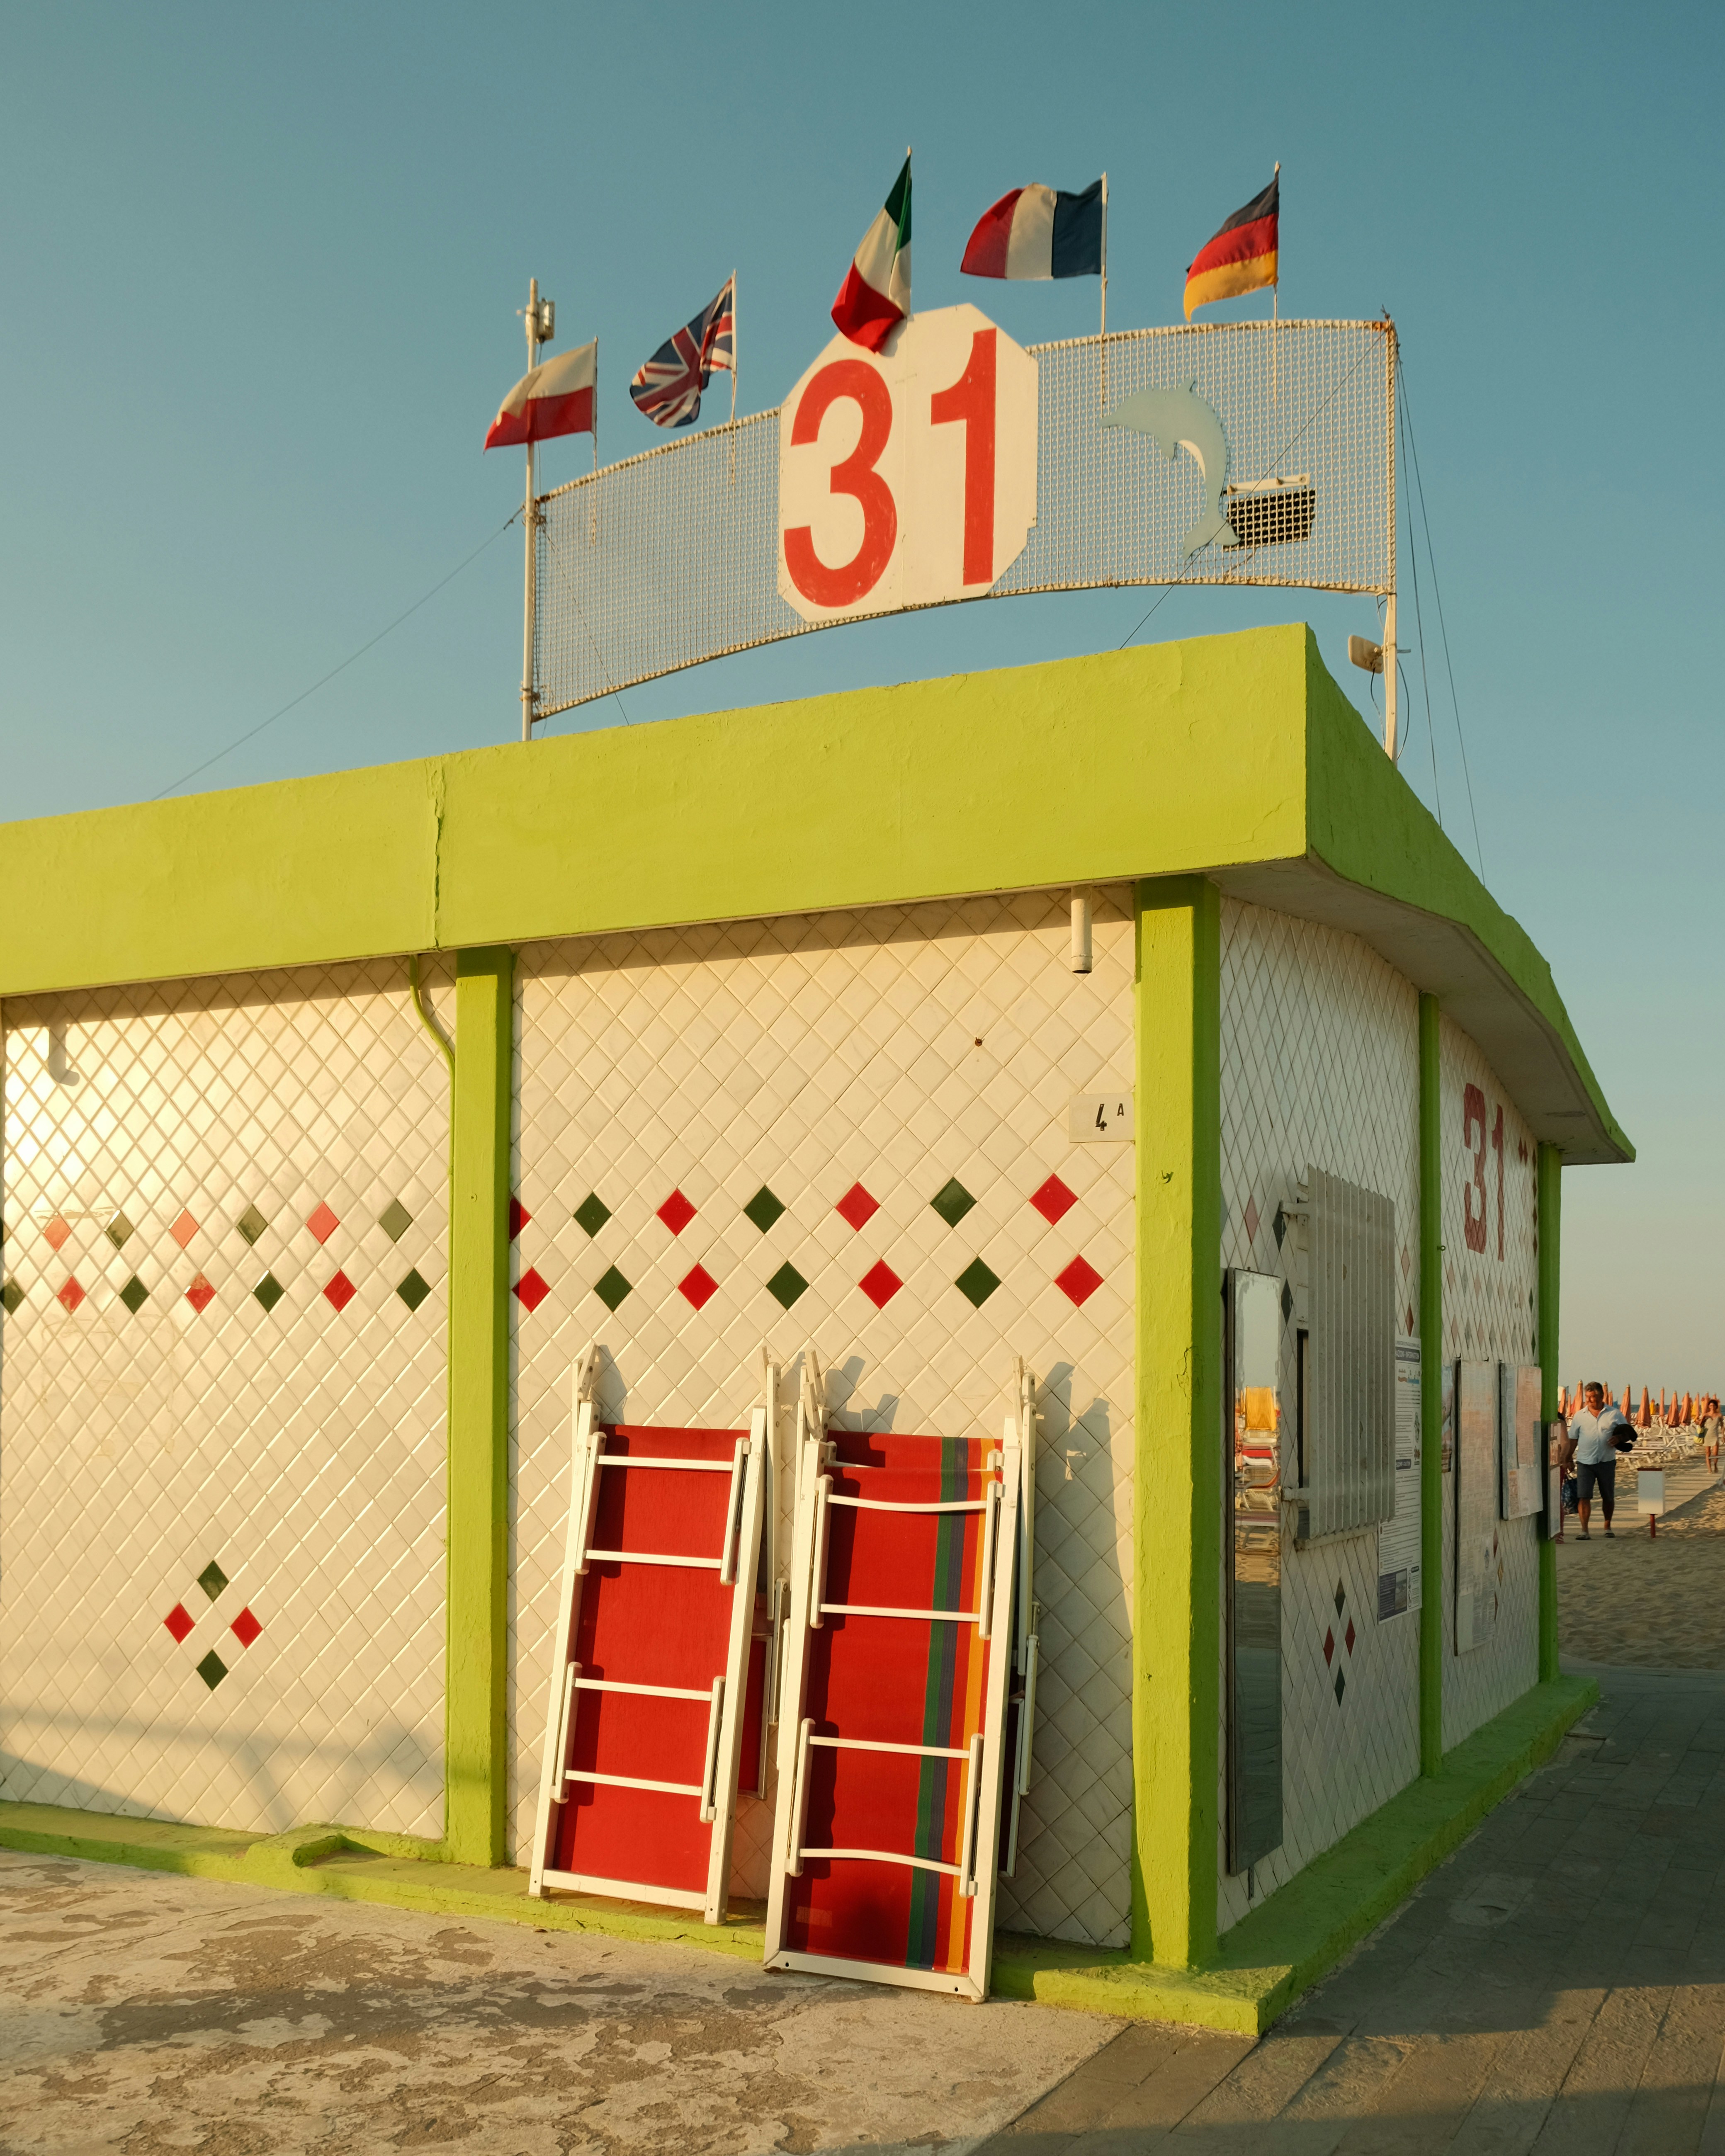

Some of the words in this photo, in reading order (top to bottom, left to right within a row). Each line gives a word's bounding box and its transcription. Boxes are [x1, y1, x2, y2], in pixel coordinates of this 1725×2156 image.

[784, 328, 997, 608] 31
[1095, 1103, 1107, 1131] 4
[1117, 1103, 1124, 1116] A
[1464, 1083, 1504, 1262] 31
